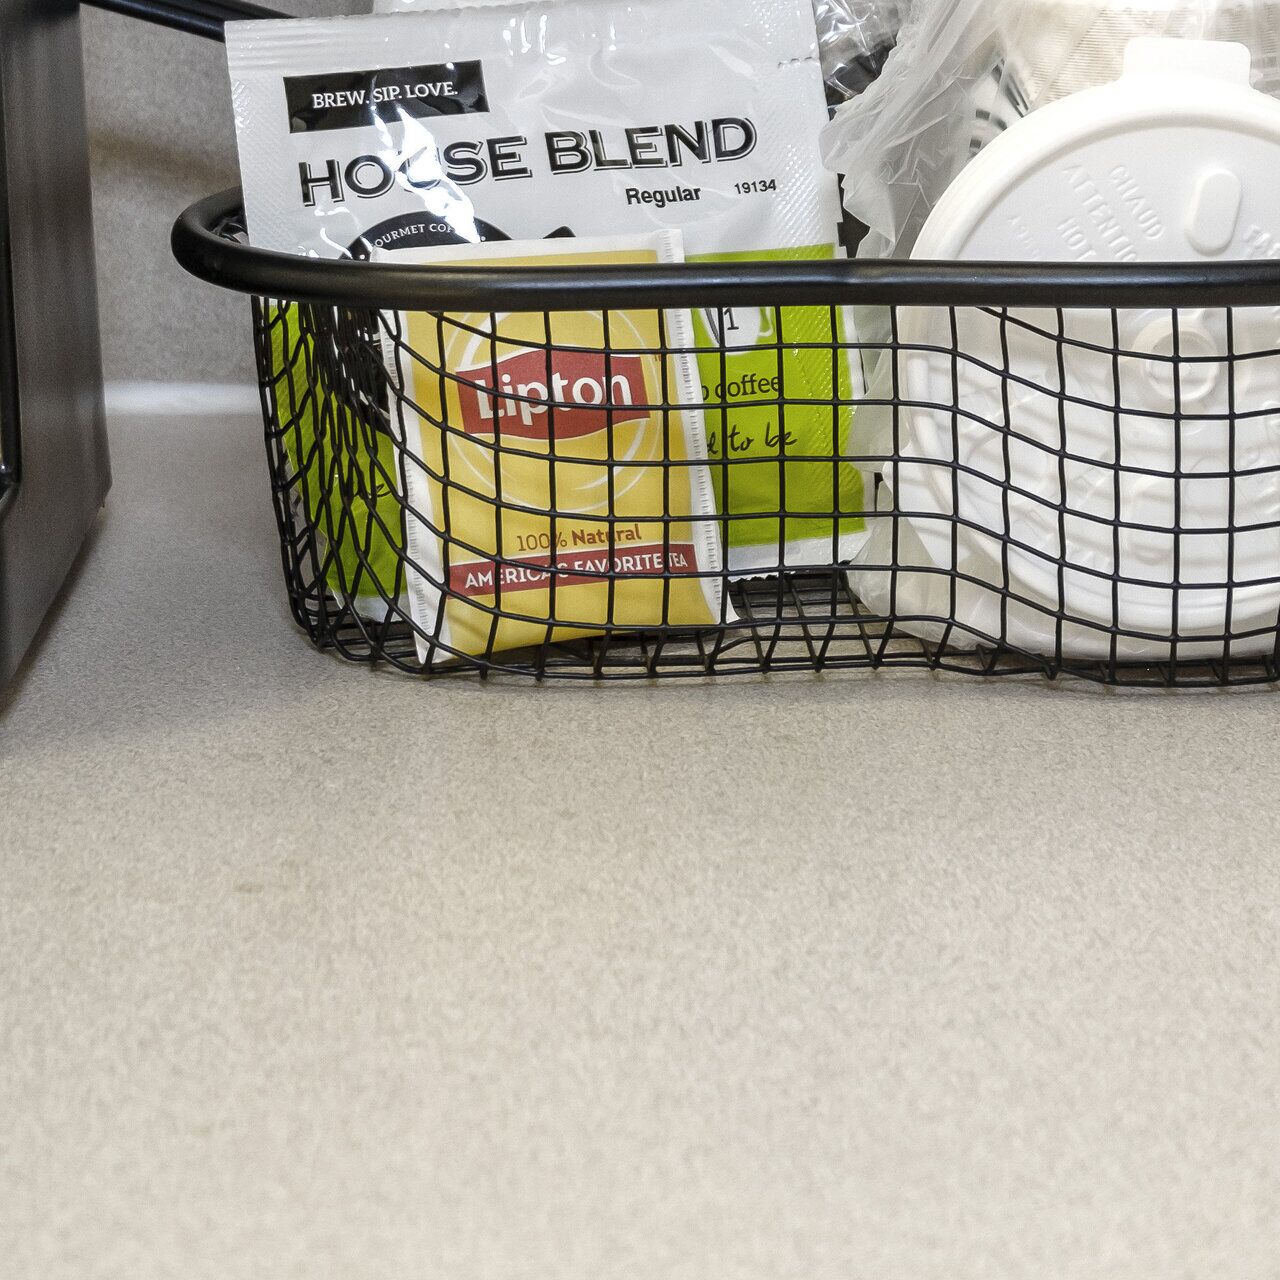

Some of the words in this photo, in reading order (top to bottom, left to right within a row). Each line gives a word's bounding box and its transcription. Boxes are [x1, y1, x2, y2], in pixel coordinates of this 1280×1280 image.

[312, 89, 369, 109] BREW.
[373, 86, 402, 103] SIP.
[407, 81, 458, 99] LOVE.
[544, 117, 758, 176] BLEND
[625, 185, 702, 209] Regular
[734, 178, 777, 195] 19134
[374, 223, 425, 248] OURMET
[474, 371, 633, 426] Lipton
[517, 532, 568, 552] 100%
[465, 562, 569, 589] AMRICS
